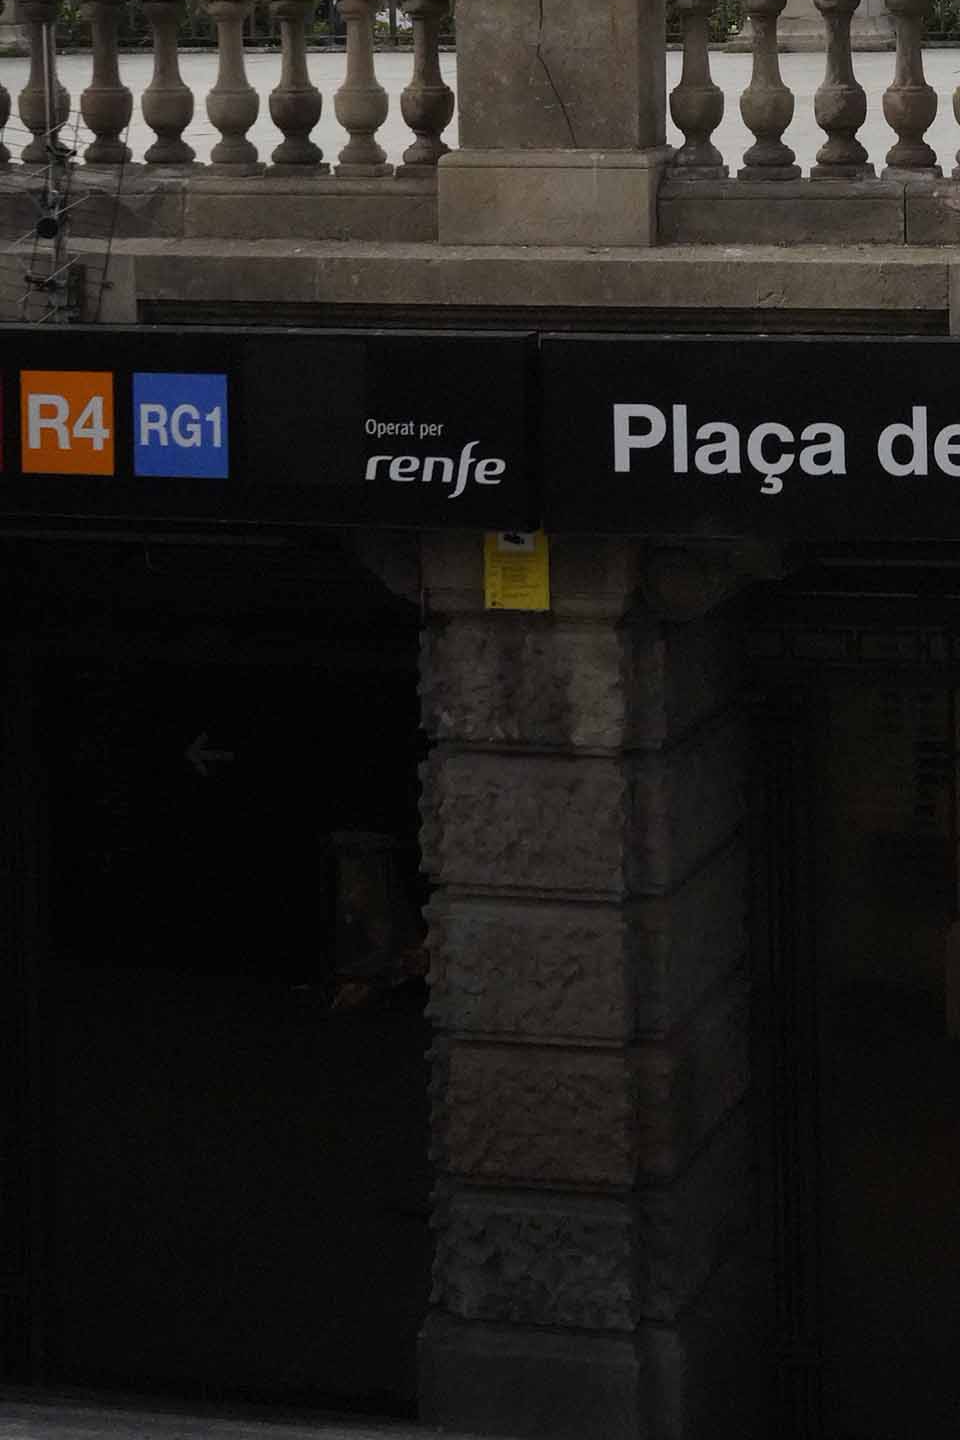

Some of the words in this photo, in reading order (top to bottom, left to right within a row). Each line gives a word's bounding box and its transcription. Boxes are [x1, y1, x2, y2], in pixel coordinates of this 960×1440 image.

[28, 393, 110, 451] R4
[139, 403, 223, 448] RG1
[365, 418, 415, 439] Operat
[419, 423, 444, 440] per
[613, 404, 846, 495] Plaça
[365, 441, 506, 499] renfe
